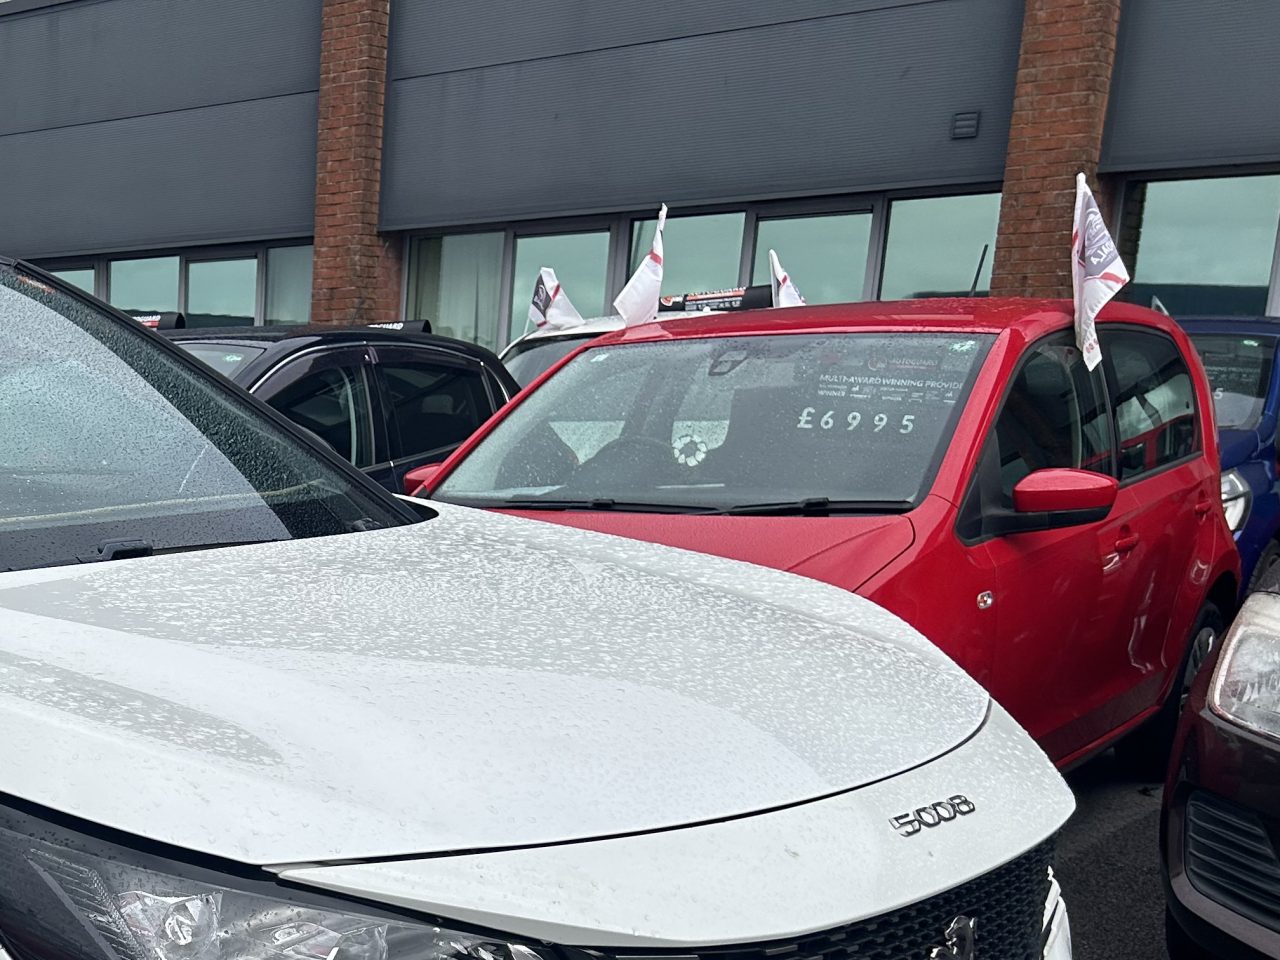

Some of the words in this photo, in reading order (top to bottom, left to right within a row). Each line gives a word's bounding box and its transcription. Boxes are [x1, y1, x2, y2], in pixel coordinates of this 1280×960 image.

[882, 377, 924, 387] WINNING
[797, 406, 915, 434] £6995
[888, 794, 976, 838] 5008
